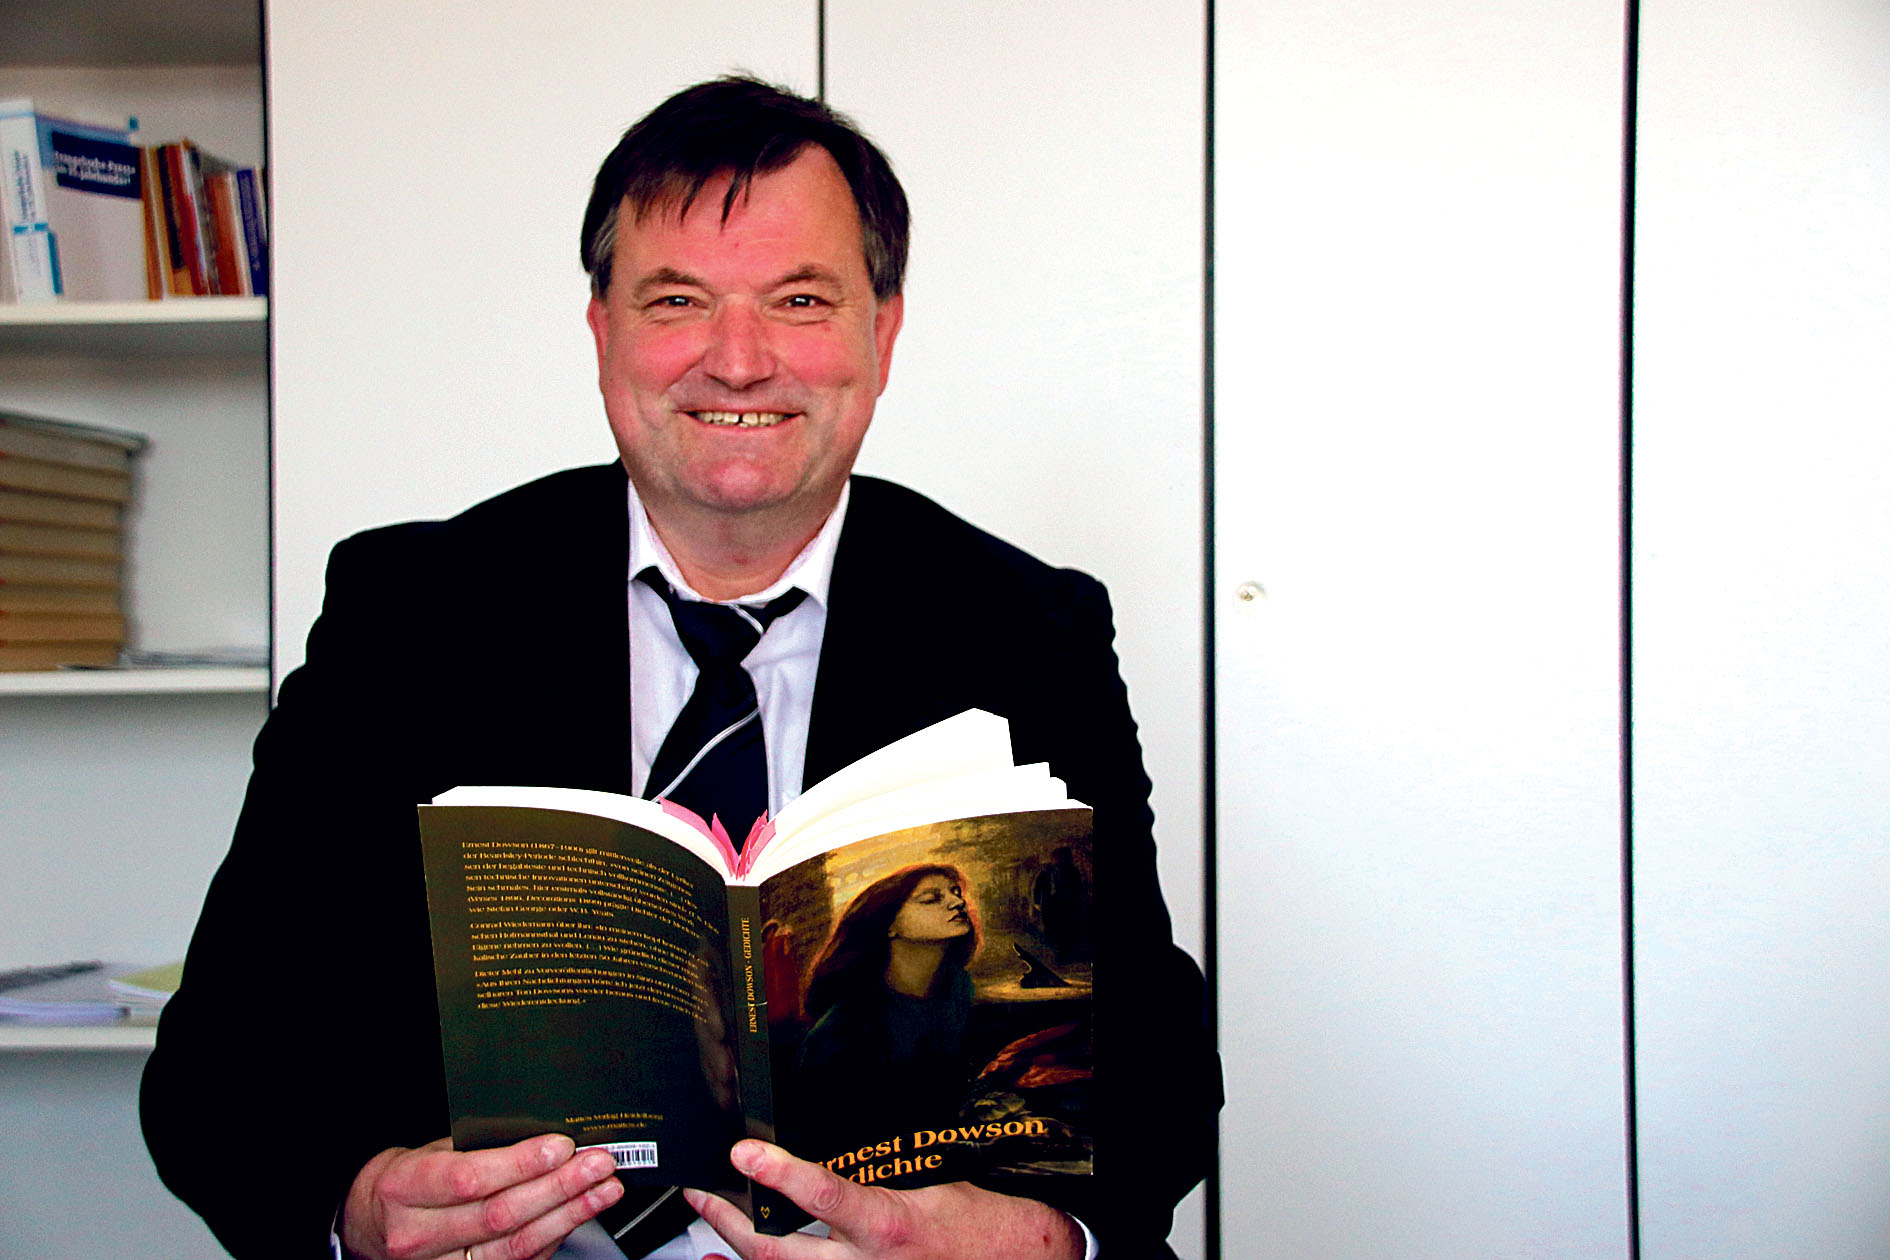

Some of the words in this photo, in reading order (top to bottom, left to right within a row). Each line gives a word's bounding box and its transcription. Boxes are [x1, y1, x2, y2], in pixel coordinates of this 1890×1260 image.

[462, 841, 490, 849] Ernest
[491, 841, 529, 849] Dowson
[741, 917, 752, 959] GEDICHTE
[744, 965, 756, 1001] DOWSON
[747, 1002, 758, 1033] ERNEST
[818, 1135, 903, 1172] rnest
[913, 1118, 1047, 1150] Dowson
[849, 1154, 943, 1186] dichte
